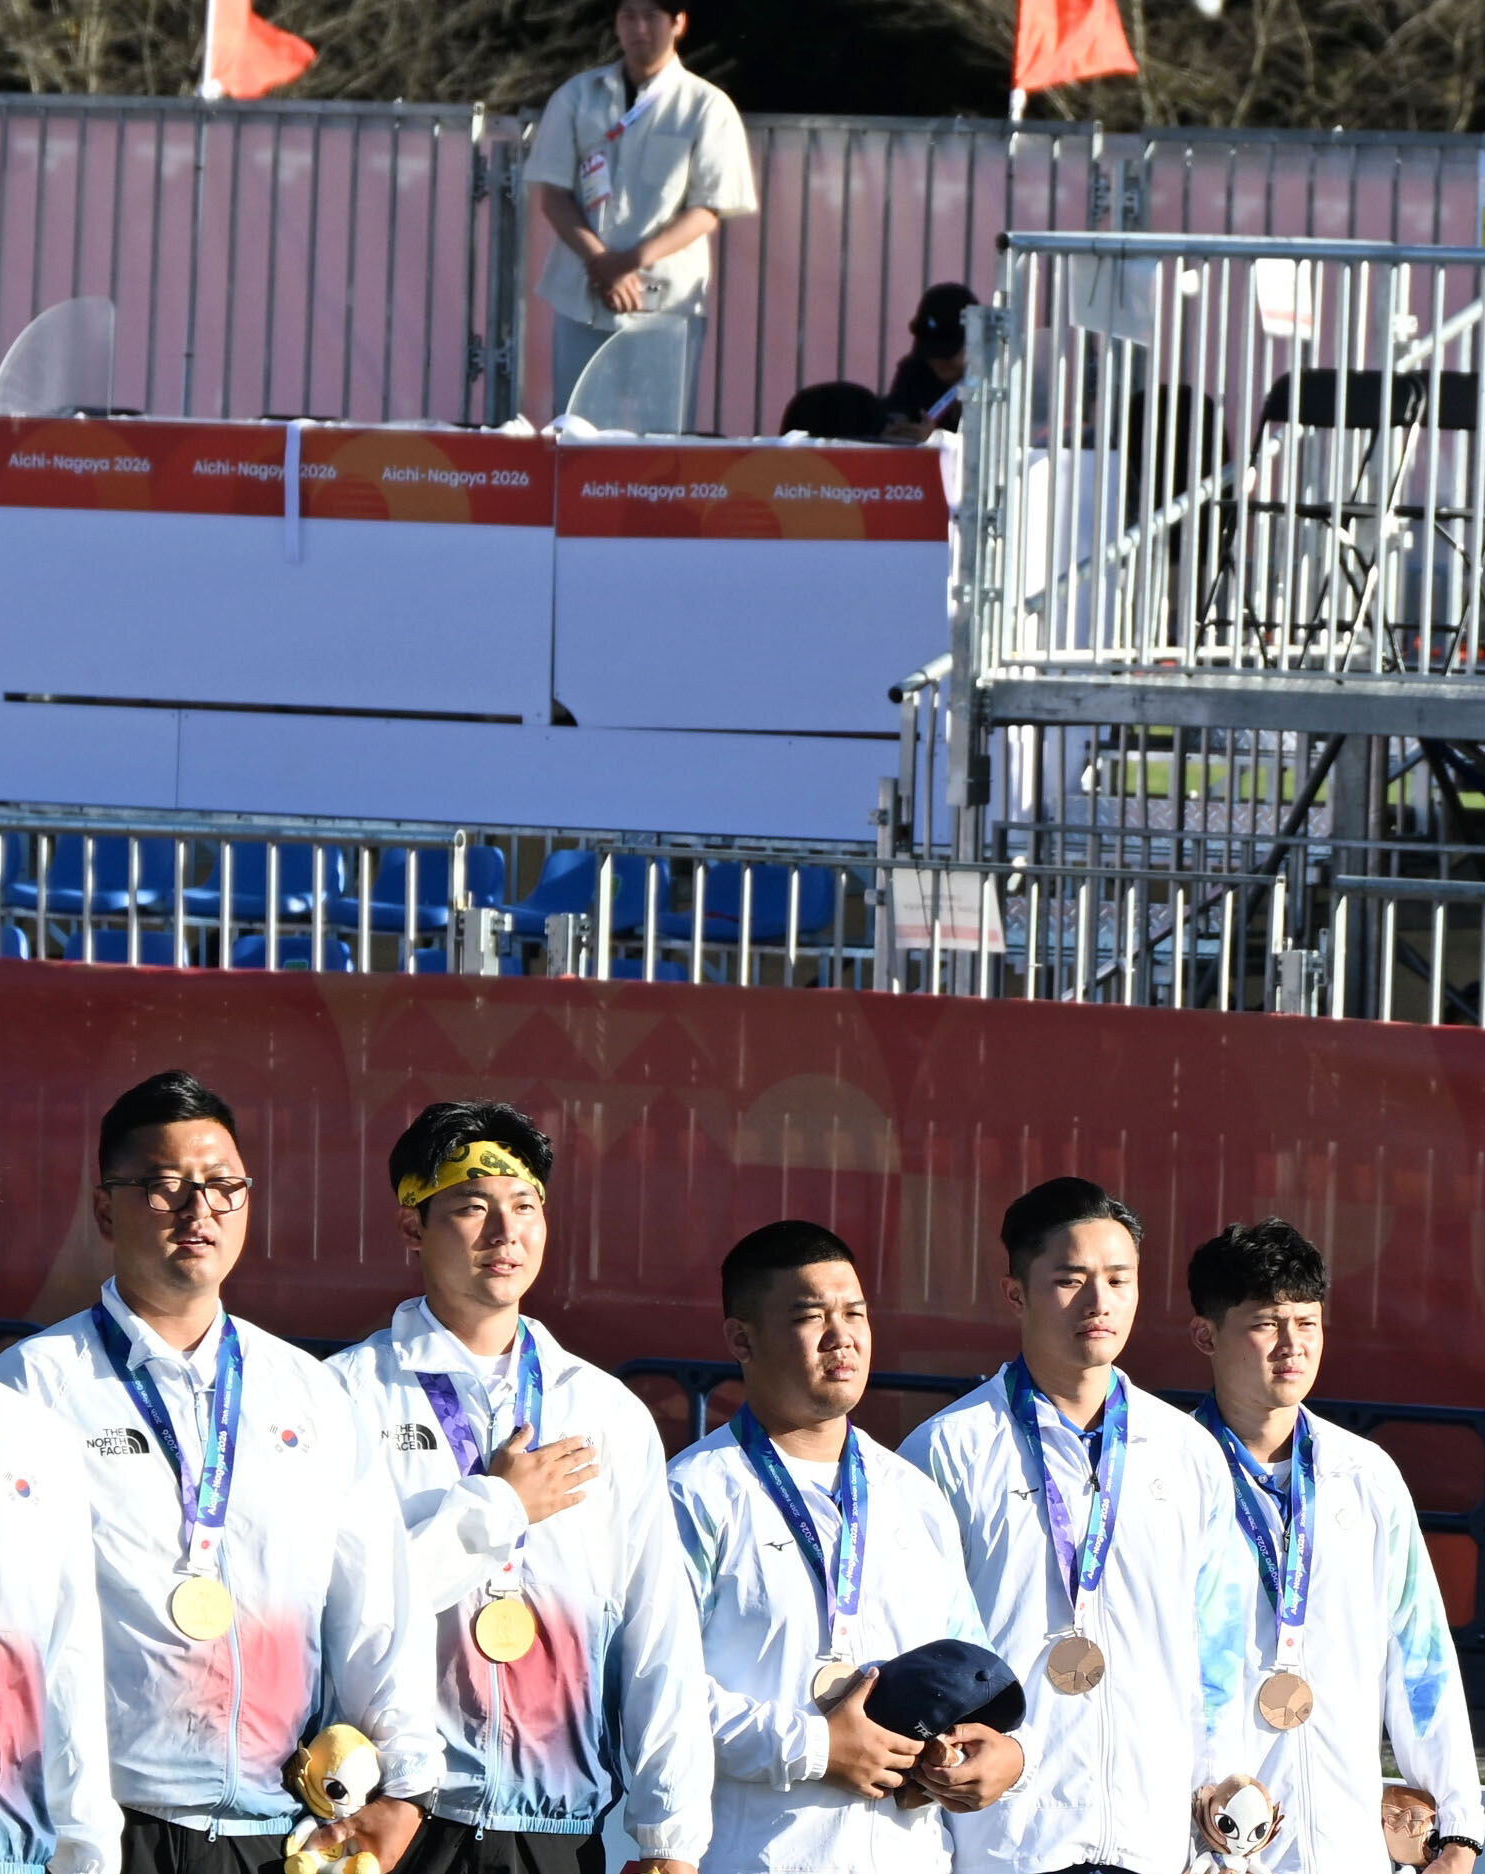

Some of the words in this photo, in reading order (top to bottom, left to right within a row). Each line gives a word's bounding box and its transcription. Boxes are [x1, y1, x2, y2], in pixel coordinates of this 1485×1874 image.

[8, 451, 111, 475] Aichi-Nagoya
[113, 455, 151, 473] 2026
[300, 463, 337, 480] 2026
[381, 464, 487, 491] Aichi-Nagoya
[490, 469, 529, 488] 2026
[581, 481, 687, 507] Aichi-Nagoya
[690, 483, 728, 501] 2026
[773, 482, 881, 508] Aichi-Nagoya
[884, 485, 923, 504] 2026
[86, 1436, 127, 1449] NORTH
[100, 1445, 130, 1457] FACE
[161, 1428, 180, 1452] 2026
[207, 1454, 225, 1516] Aichi-Nagoya
[218, 1430, 227, 1453] 2026
[1099, 1498, 1111, 1521] 2026
[799, 1521, 815, 1543] 2026
[1256, 1535, 1269, 1557] 2026
[1297, 1533, 1305, 1555] 2026
